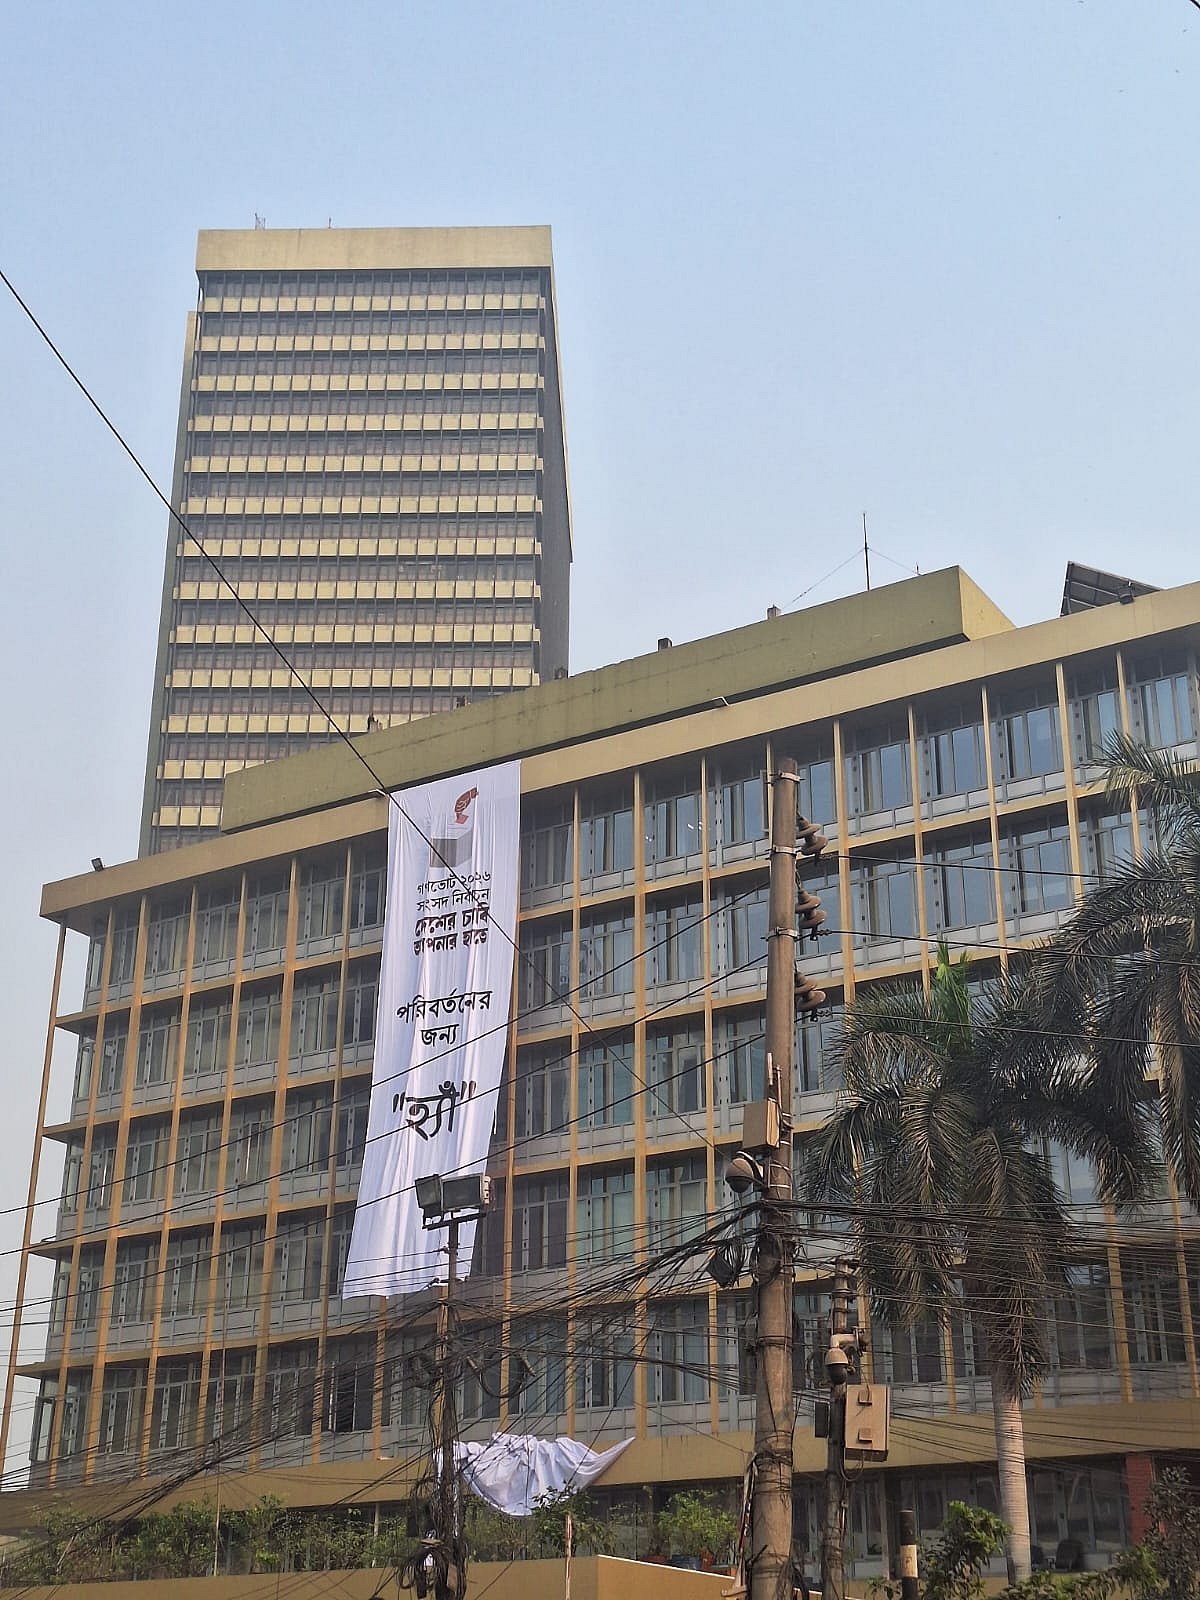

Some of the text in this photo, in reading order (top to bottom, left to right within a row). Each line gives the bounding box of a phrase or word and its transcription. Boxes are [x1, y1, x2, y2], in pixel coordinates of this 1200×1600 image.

[417, 873, 457, 895] গণভোট
[417, 886, 490, 912] সংসদ নির্বাচন
[415, 902, 489, 937] দেশের চাবি
[413, 928, 488, 955] আপনার হাতে
[396, 988, 493, 1023] পরিবর্তনের
[421, 1024, 459, 1047] জন্য
